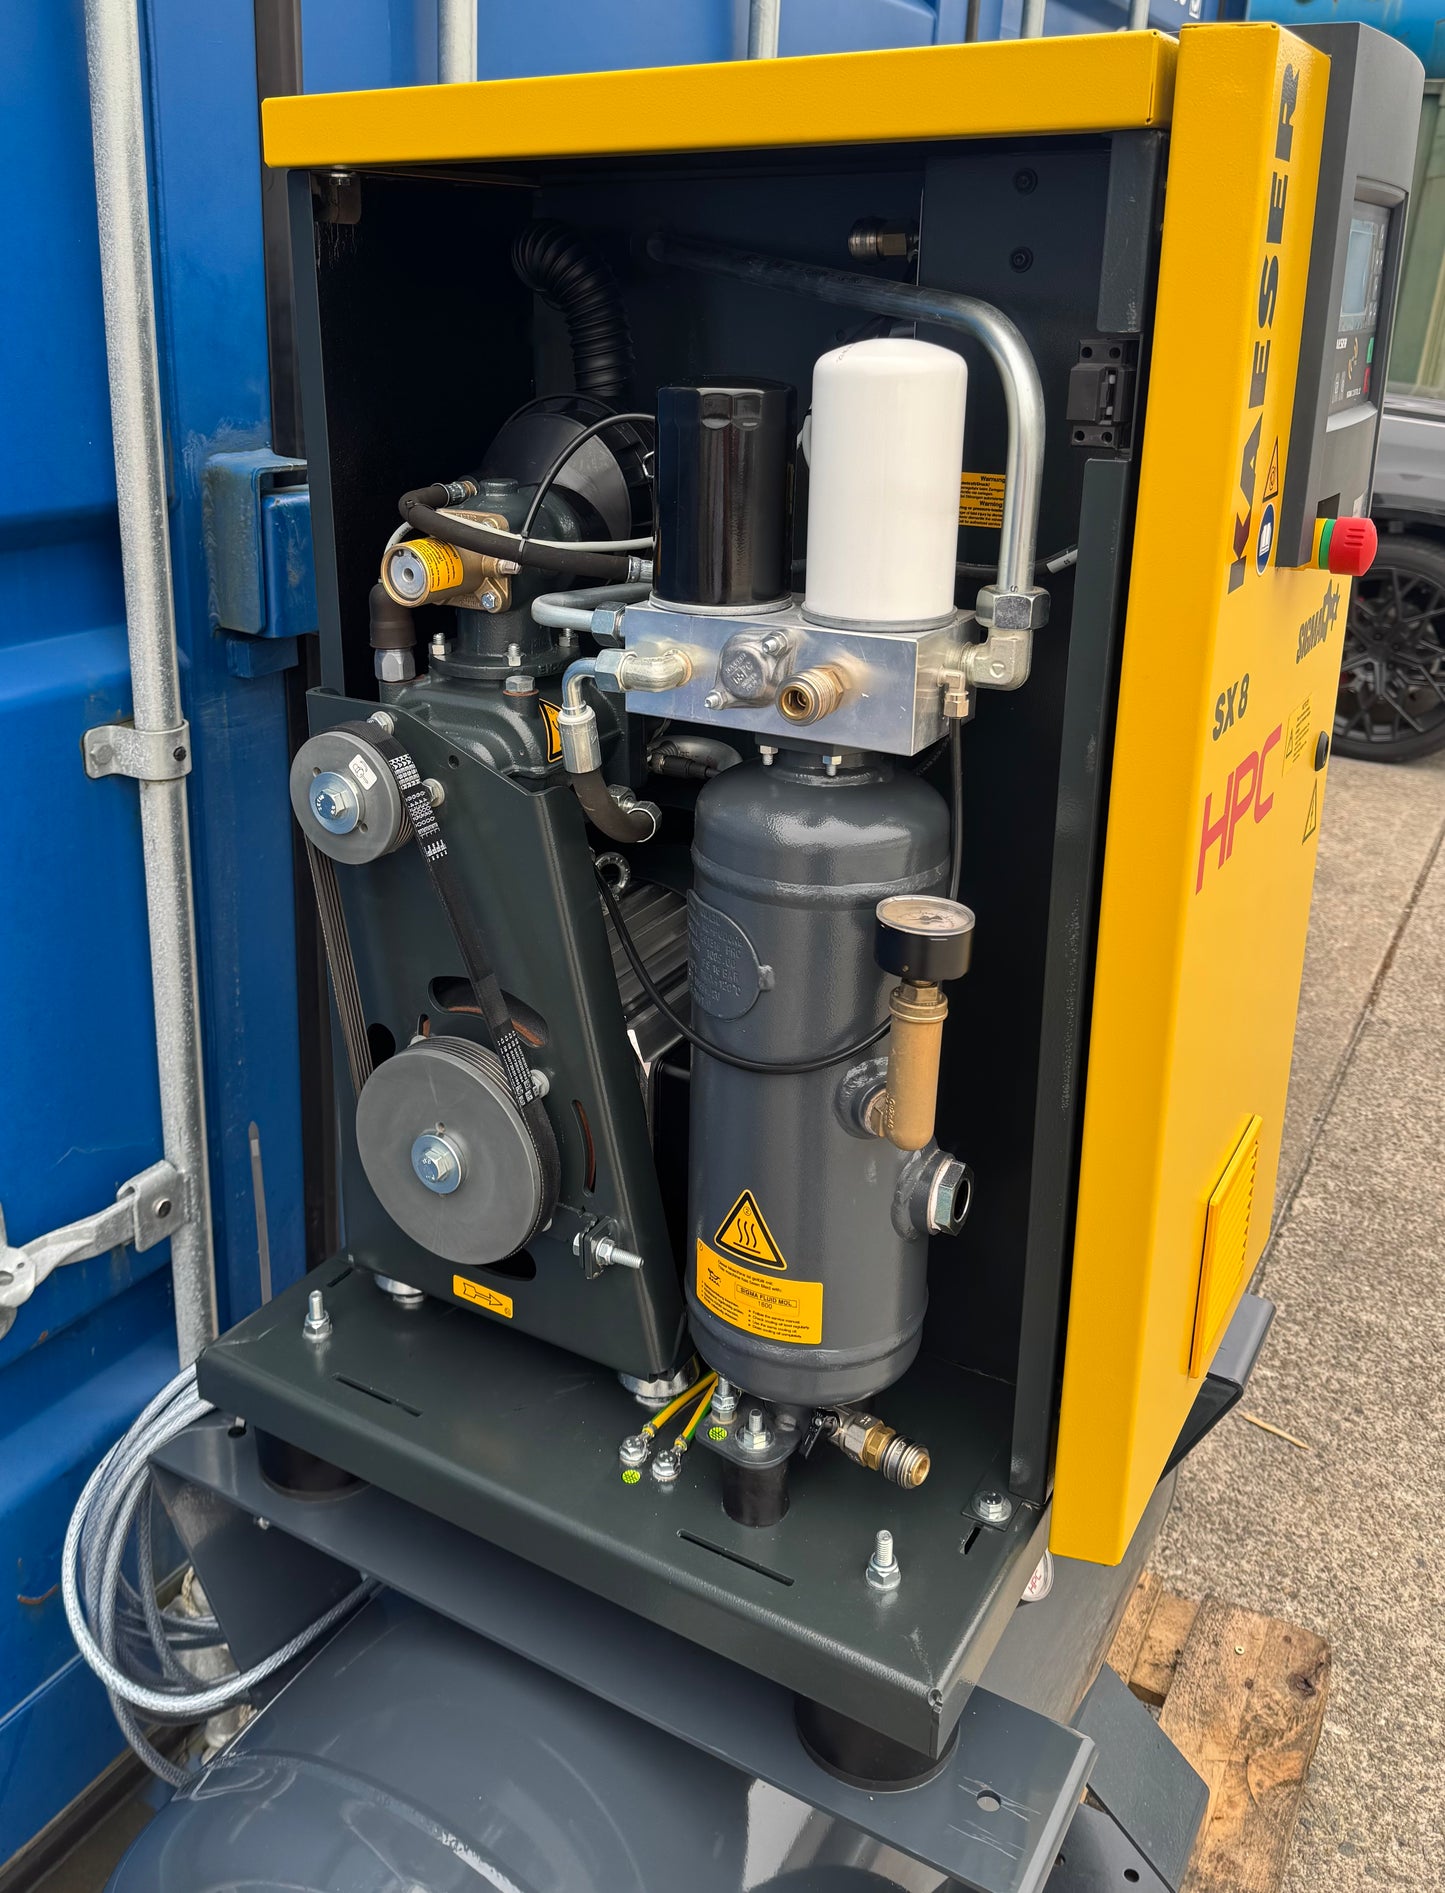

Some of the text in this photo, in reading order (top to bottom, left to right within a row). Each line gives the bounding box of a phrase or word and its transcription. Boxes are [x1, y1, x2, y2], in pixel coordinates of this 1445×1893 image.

[1228, 62, 1300, 593] KAESER
[1212, 680, 1239, 742] SX
[1237, 673, 1250, 720] 8
[1195, 722, 1283, 896] HPC
[759, 1293, 778, 1304] FLUID
